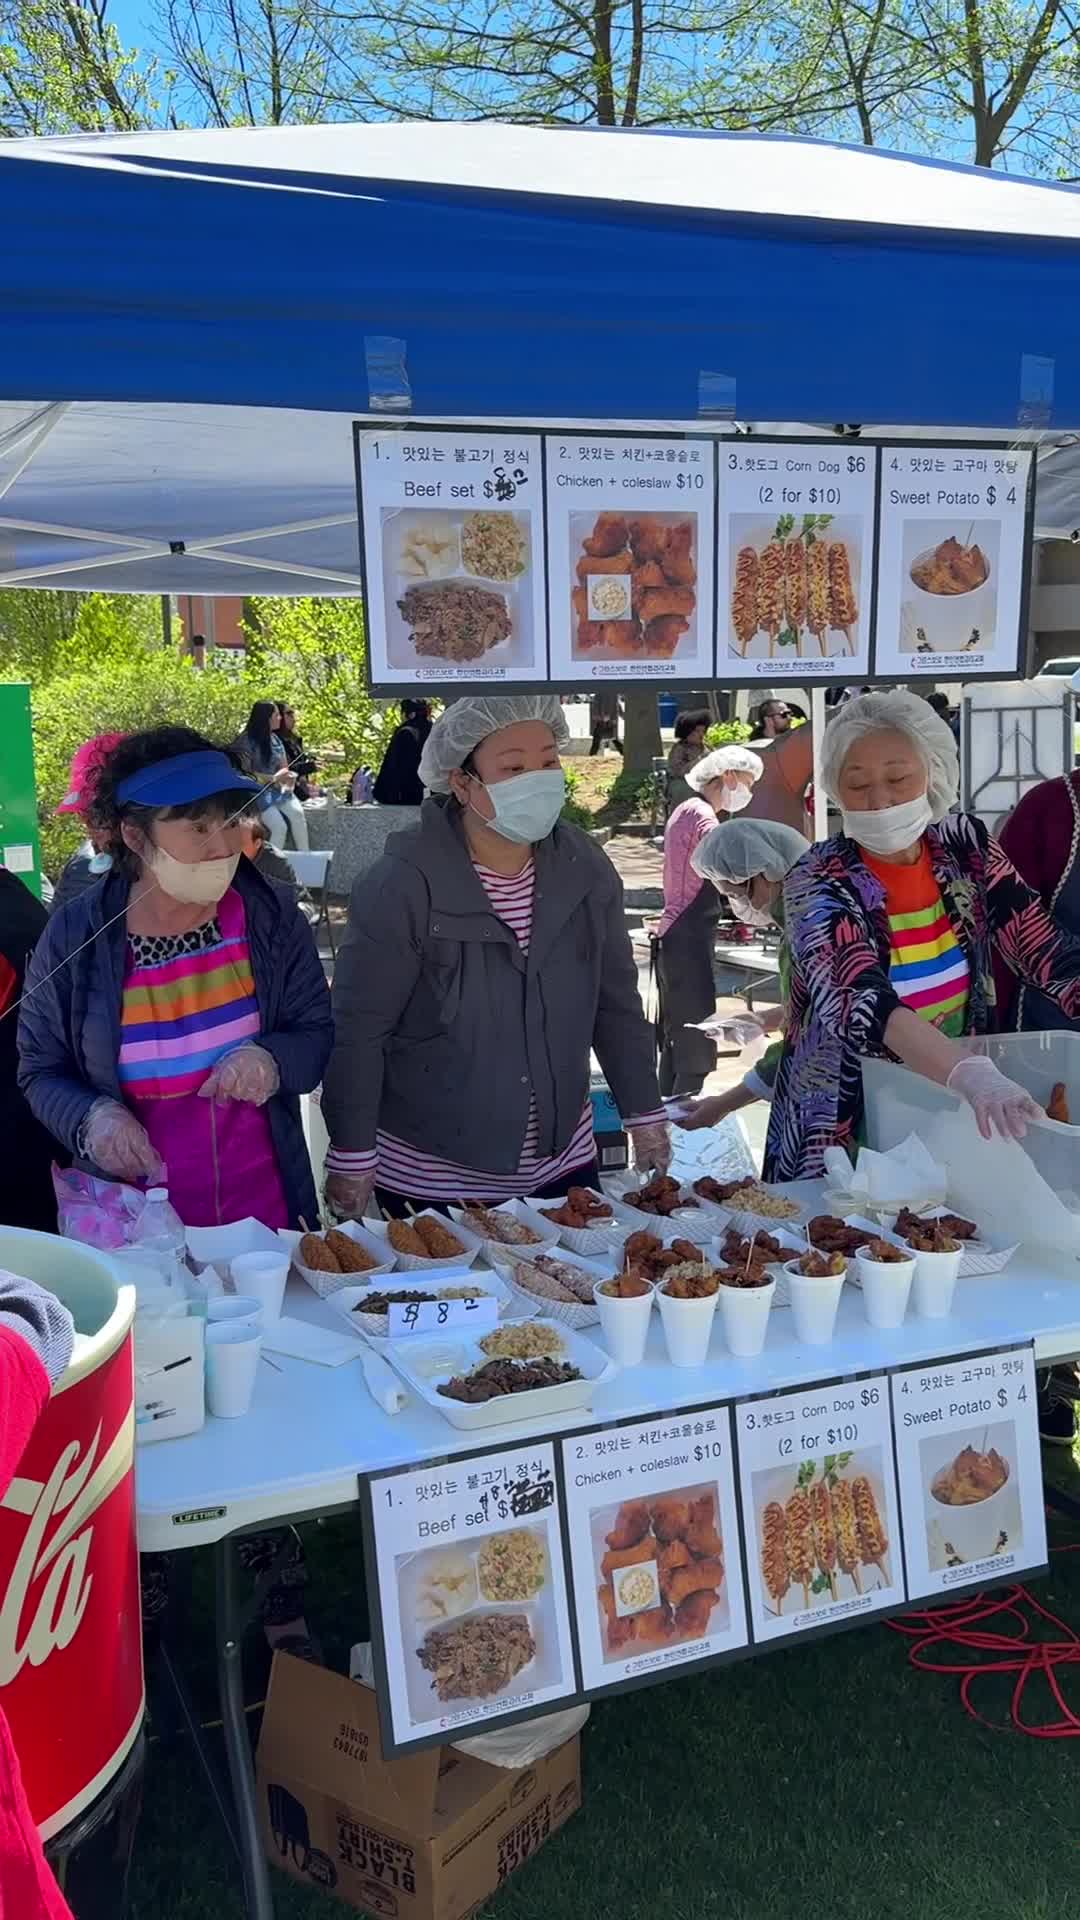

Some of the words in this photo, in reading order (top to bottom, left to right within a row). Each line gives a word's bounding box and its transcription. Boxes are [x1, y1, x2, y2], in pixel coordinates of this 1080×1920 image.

[373, 442, 390, 460] 1.
[402, 447, 445, 462] 맛있는
[454, 448, 494, 463] 불고기
[504, 450, 529, 464] 정식
[559, 446, 571, 459] 2.
[579, 447, 615, 461] 맛있는
[786, 460, 811, 472] Corn
[818, 460, 840, 473] Dog
[847, 456, 866, 473] $6
[890, 457, 902, 471] 4.
[910, 459, 945, 472] 맛있는
[953, 460, 987, 472] 고구마
[404, 482, 442, 496] Beef
[450, 484, 476, 497] set
[556, 474, 602, 487] Chicken
[608, 478, 616, 486] +
[622, 476, 671, 488] coleslaw
[676, 473, 704, 489] $10
[759, 486, 774, 504] (2
[782, 488, 802, 502] for
[808, 487, 841, 504] $10)
[890, 490, 931, 504] Sweet
[937, 490, 980, 504] Potato
[901, 1382, 913, 1394] 4.
[920, 1374, 955, 1392] 맛있는
[962, 1366, 996, 1382] 고구마
[802, 1405, 828, 1418] Corn
[834, 1400, 855, 1412] Dog
[861, 1388, 880, 1406] $6
[904, 1408, 943, 1426] Sweet
[950, 1400, 991, 1416] Potato
[575, 1447, 589, 1459] 2.
[594, 1438, 632, 1456] 맛있는
[778, 1438, 792, 1456] (2
[801, 1434, 820, 1449] for
[827, 1424, 858, 1445] $10)
[575, 1469, 622, 1486] Chicken
[627, 1465, 635, 1474] +
[640, 1455, 690, 1473] coleslaw
[694, 1442, 721, 1462] $10
[385, 1489, 403, 1507] 1.
[415, 1480, 457, 1502] 맛있는
[466, 1468, 508, 1490] 불고기
[516, 1460, 543, 1478] 정식
[418, 1514, 456, 1537] Beef
[465, 1509, 490, 1526] set
[337, 1828, 415, 1874] T-SHIRT
[338, 1842, 416, 1893] BLACK
